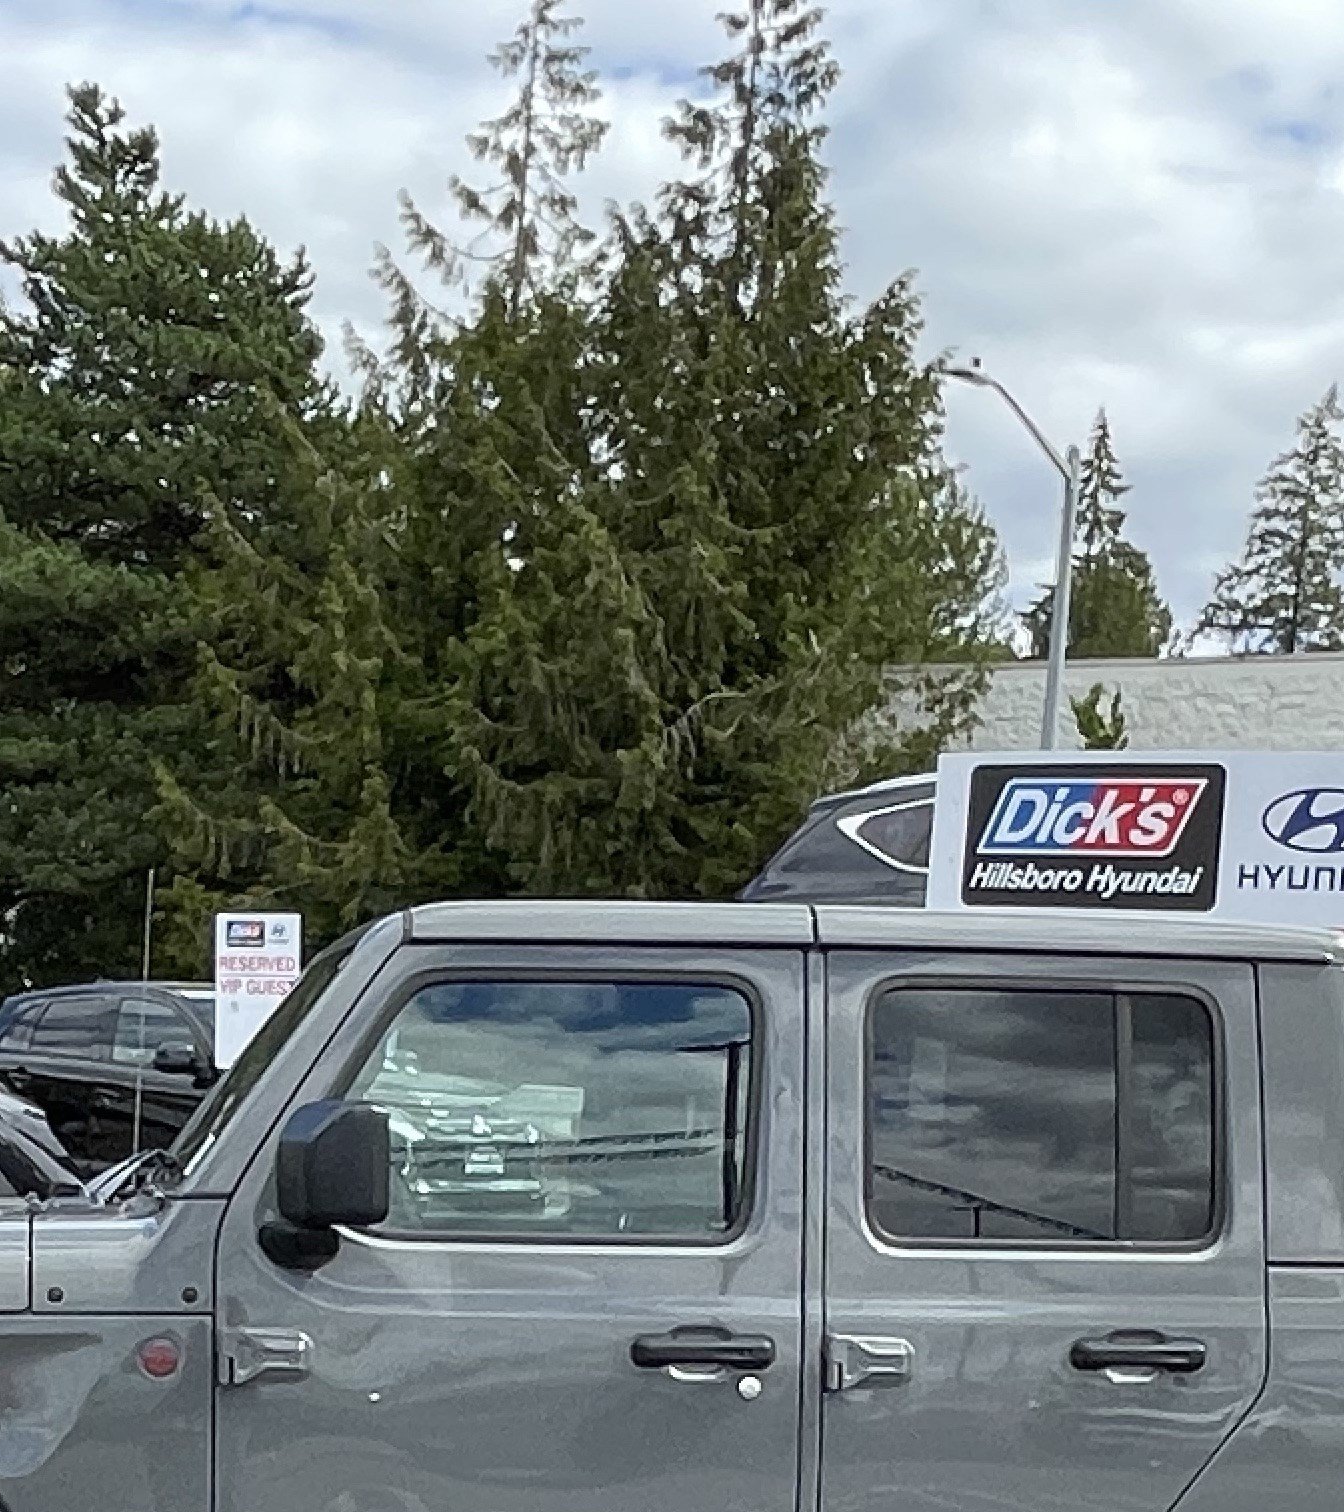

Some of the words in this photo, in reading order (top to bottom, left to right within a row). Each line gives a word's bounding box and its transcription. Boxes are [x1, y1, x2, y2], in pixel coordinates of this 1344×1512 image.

[993, 787, 1176, 846] Dick's
[969, 862, 1084, 891] Hillsboro
[1085, 864, 1204, 899] Hyundai
[219, 956, 296, 972] RESERVED
[220, 978, 242, 994] VIP
